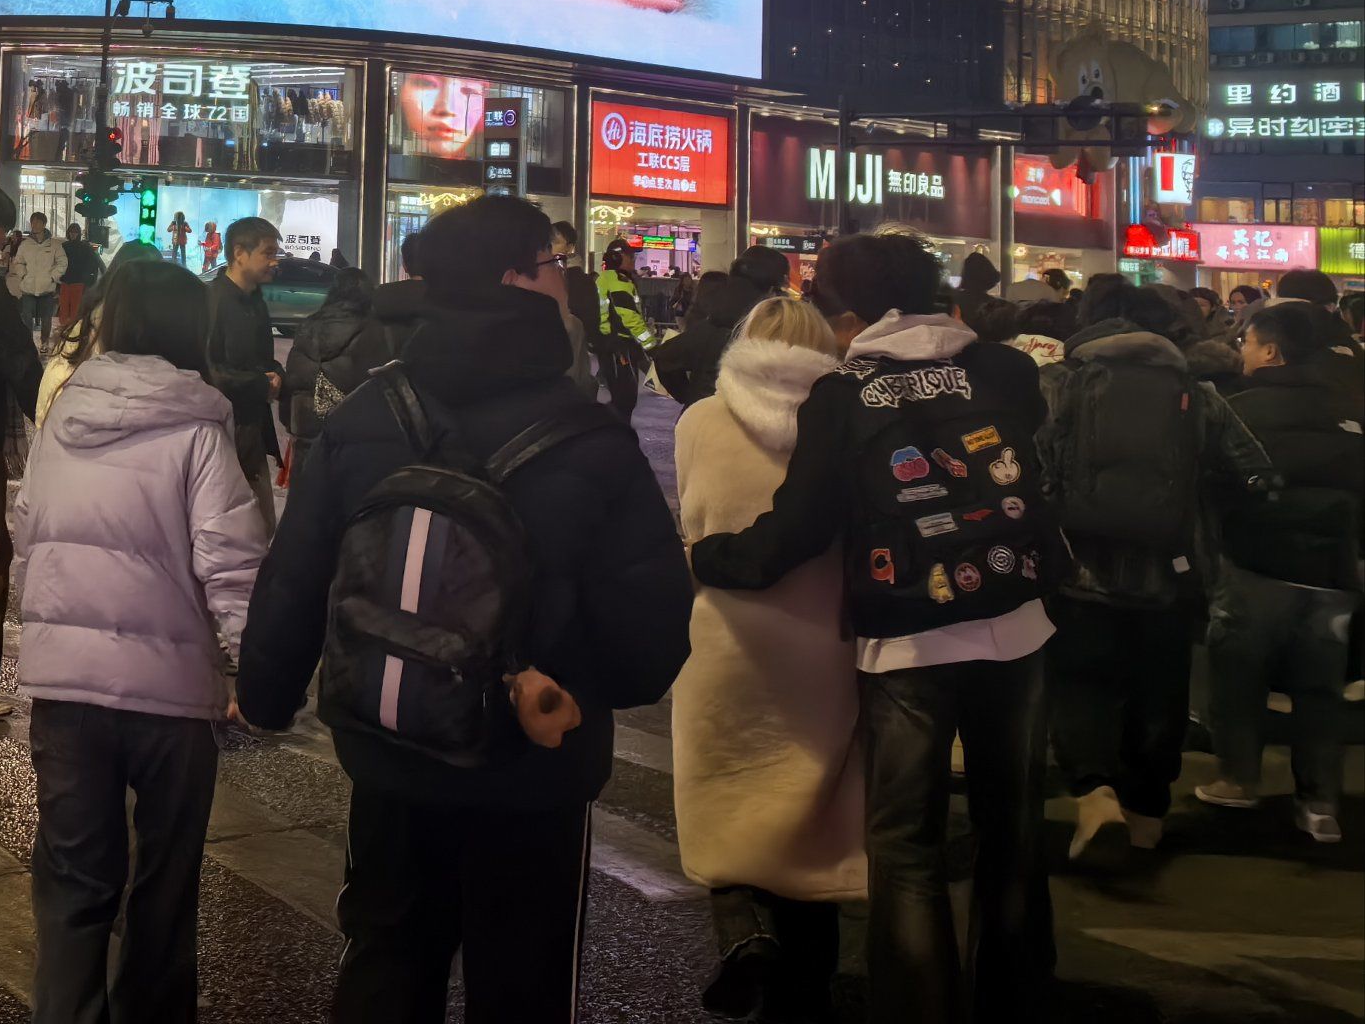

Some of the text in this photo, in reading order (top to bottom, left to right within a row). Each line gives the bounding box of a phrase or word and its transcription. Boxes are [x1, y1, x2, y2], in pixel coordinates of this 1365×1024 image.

[113, 62, 252, 100] 波司登
[1226, 82, 1365, 105] 里约酒
[112, 101, 250, 123] 畅销全球72国
[629, 121, 713, 154] 海底捞火锅
[637, 152, 691, 173] 工联CC5层
[888, 169, 944, 198] 無印良品
[285, 234, 322, 245] 波司登
